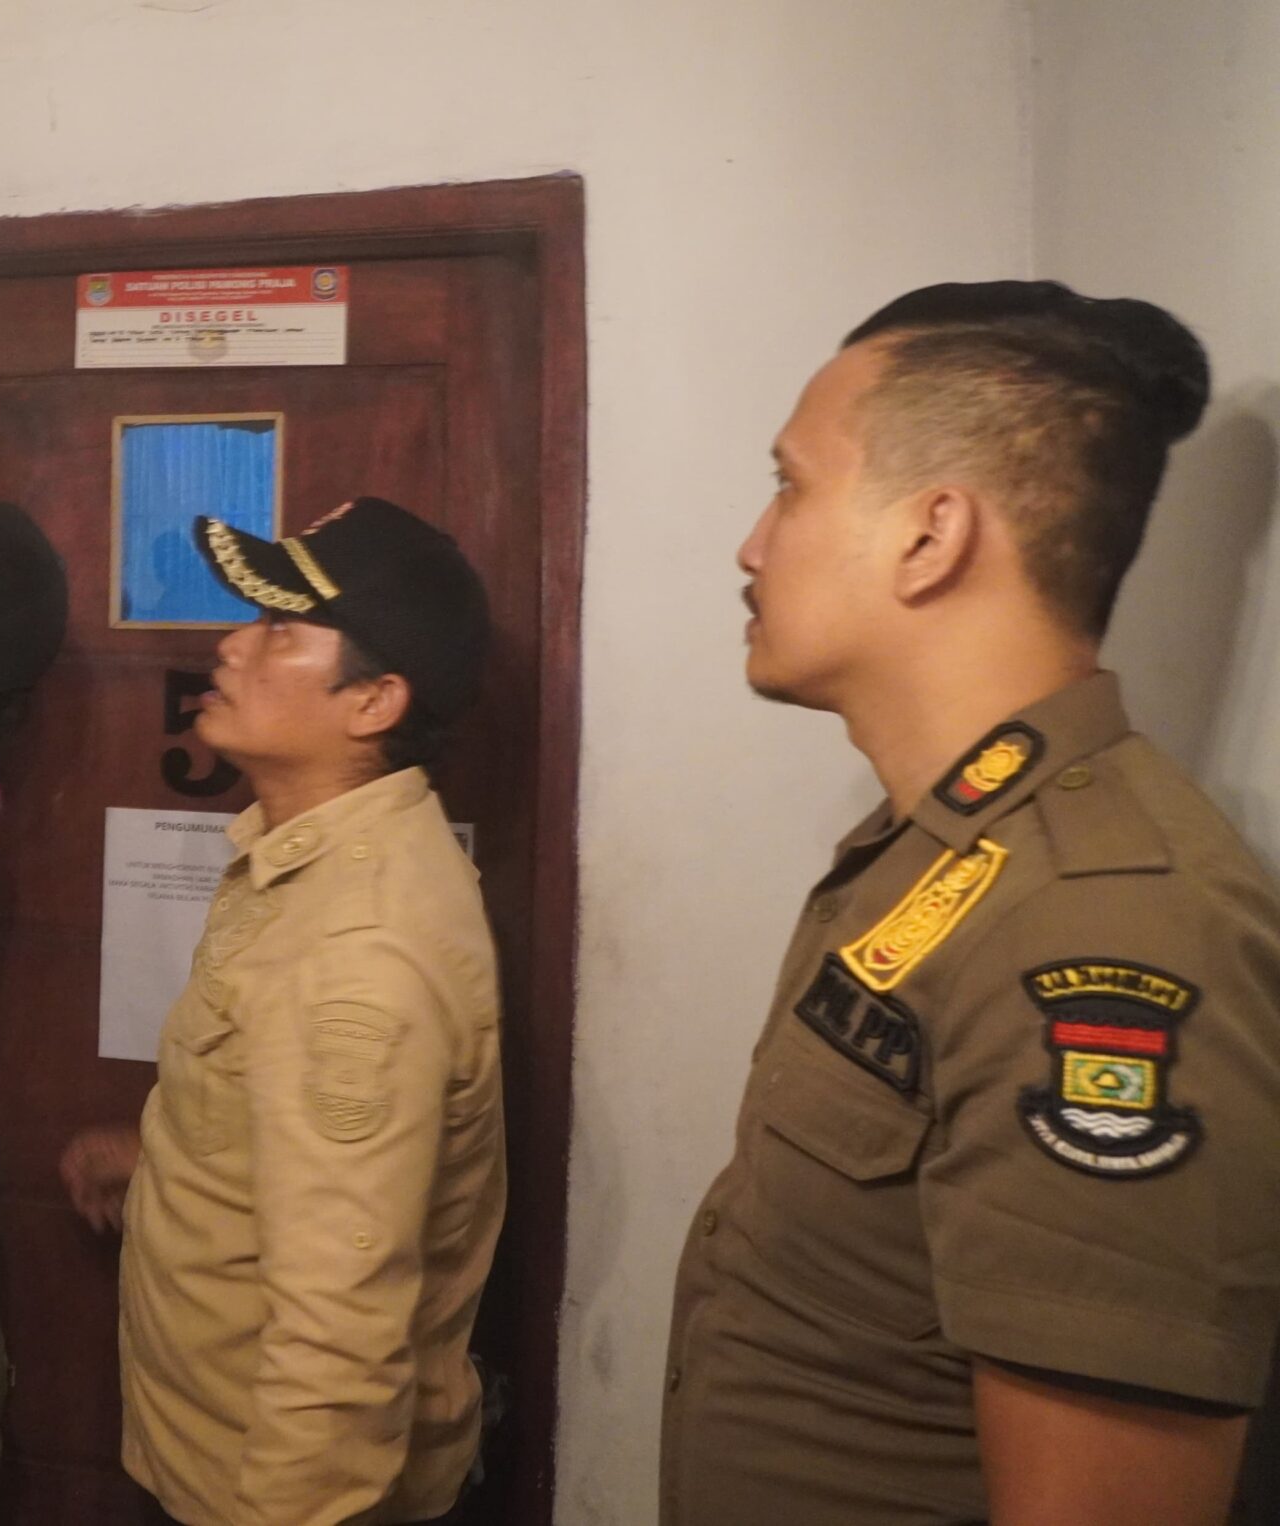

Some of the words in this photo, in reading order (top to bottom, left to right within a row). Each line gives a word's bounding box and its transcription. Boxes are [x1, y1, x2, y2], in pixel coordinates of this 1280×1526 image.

[159, 310, 258, 324] DISEGEL
[159, 668, 243, 797] 5
[154, 821, 226, 834] PENGUMUMA
